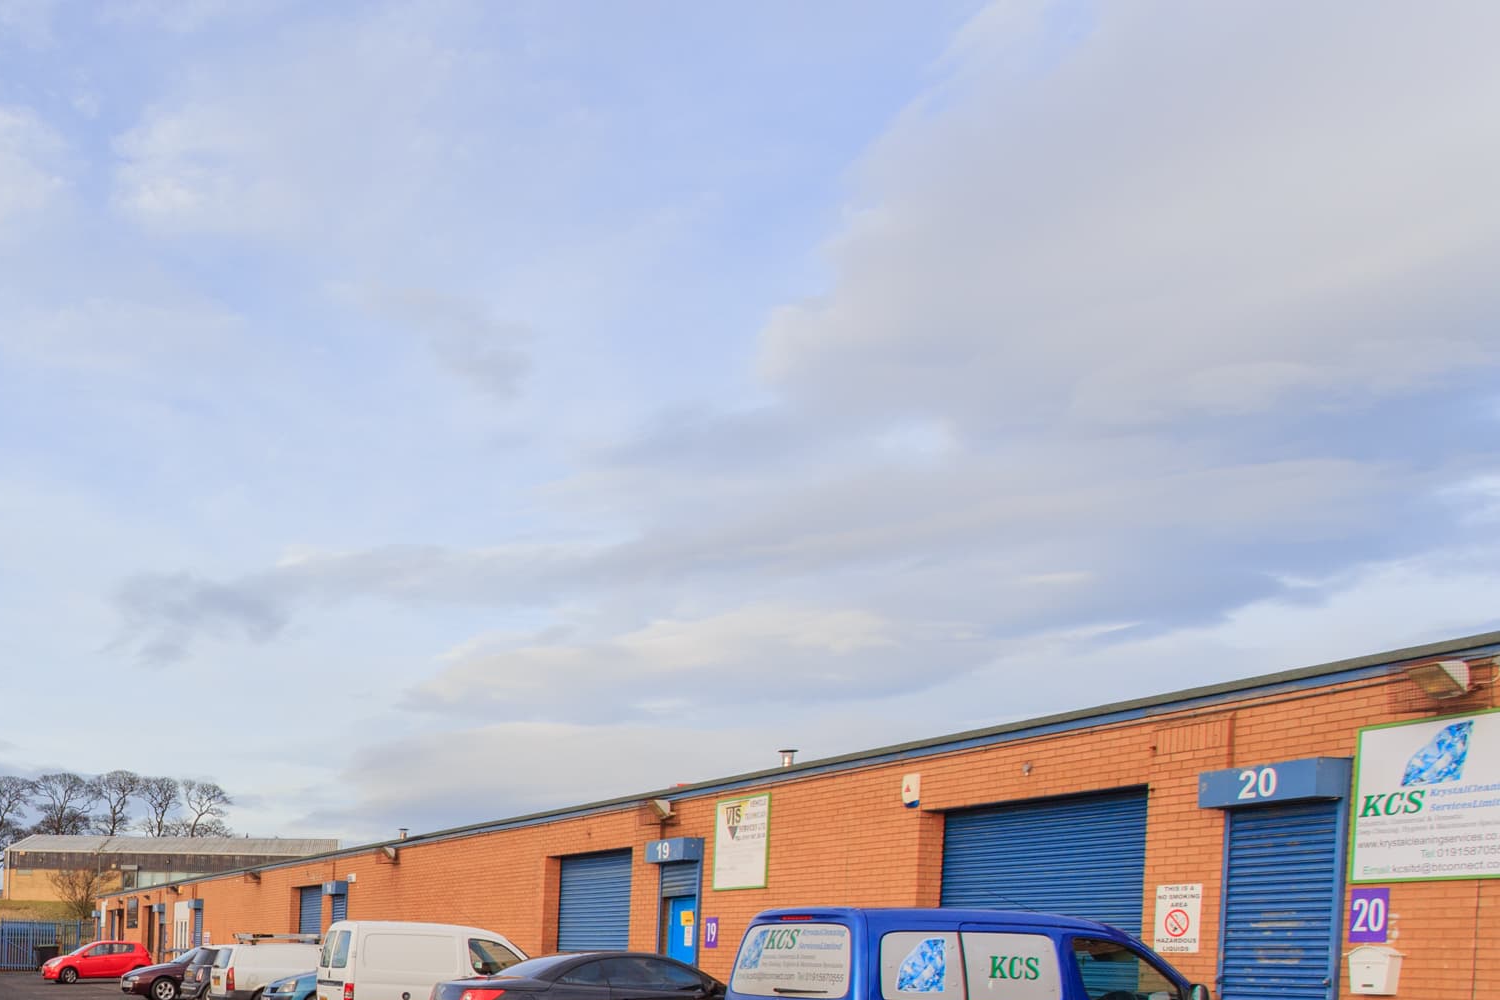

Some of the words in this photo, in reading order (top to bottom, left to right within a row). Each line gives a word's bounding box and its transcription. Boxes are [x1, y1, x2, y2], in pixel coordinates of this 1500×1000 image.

[1238, 767, 1277, 800] 20
[725, 805, 742, 825] VTS
[1358, 790, 1425, 818] KCS
[656, 842, 670, 859] 19
[1351, 898, 1385, 932] 20
[706, 922, 717, 942] 19
[764, 928, 801, 950] KCS
[988, 955, 1040, 980] KCS
